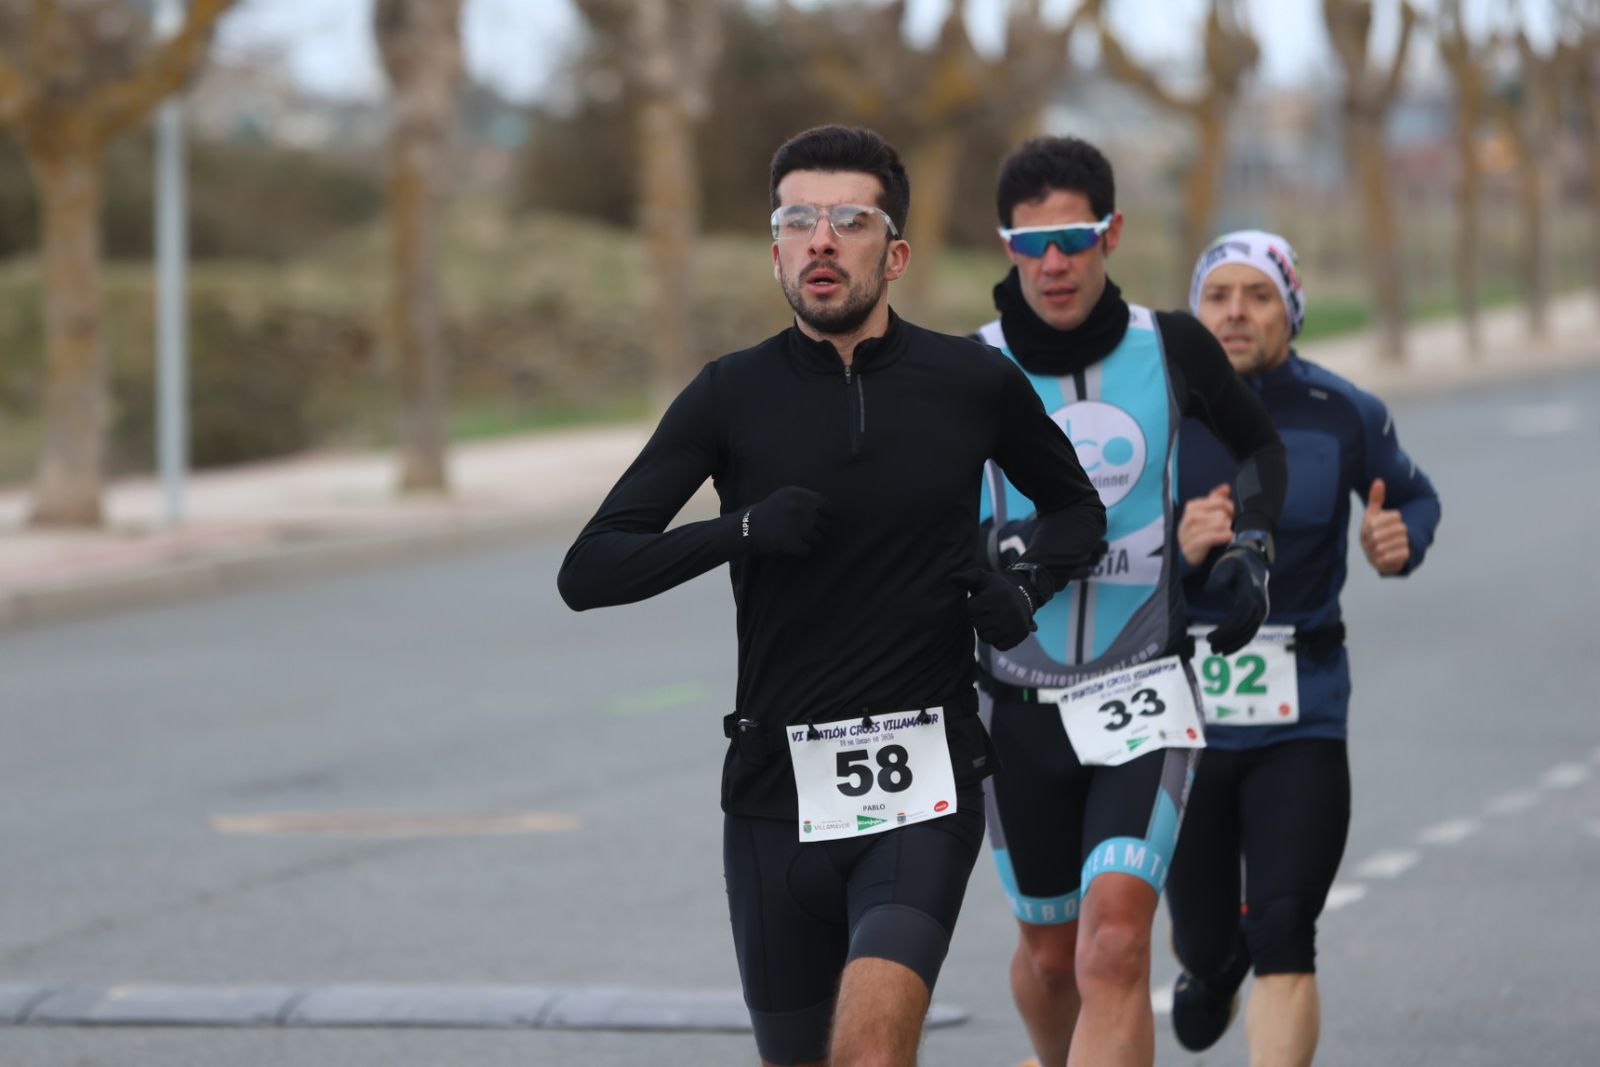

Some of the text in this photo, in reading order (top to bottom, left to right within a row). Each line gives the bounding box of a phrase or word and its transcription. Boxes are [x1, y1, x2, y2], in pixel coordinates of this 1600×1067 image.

[1202, 653, 1268, 697] 92
[1098, 688, 1166, 731] 33
[791, 730, 804, 743] VI
[850, 721, 881, 737] CROSS
[836, 744, 913, 797] 58
[862, 804, 886, 812] PABLO
